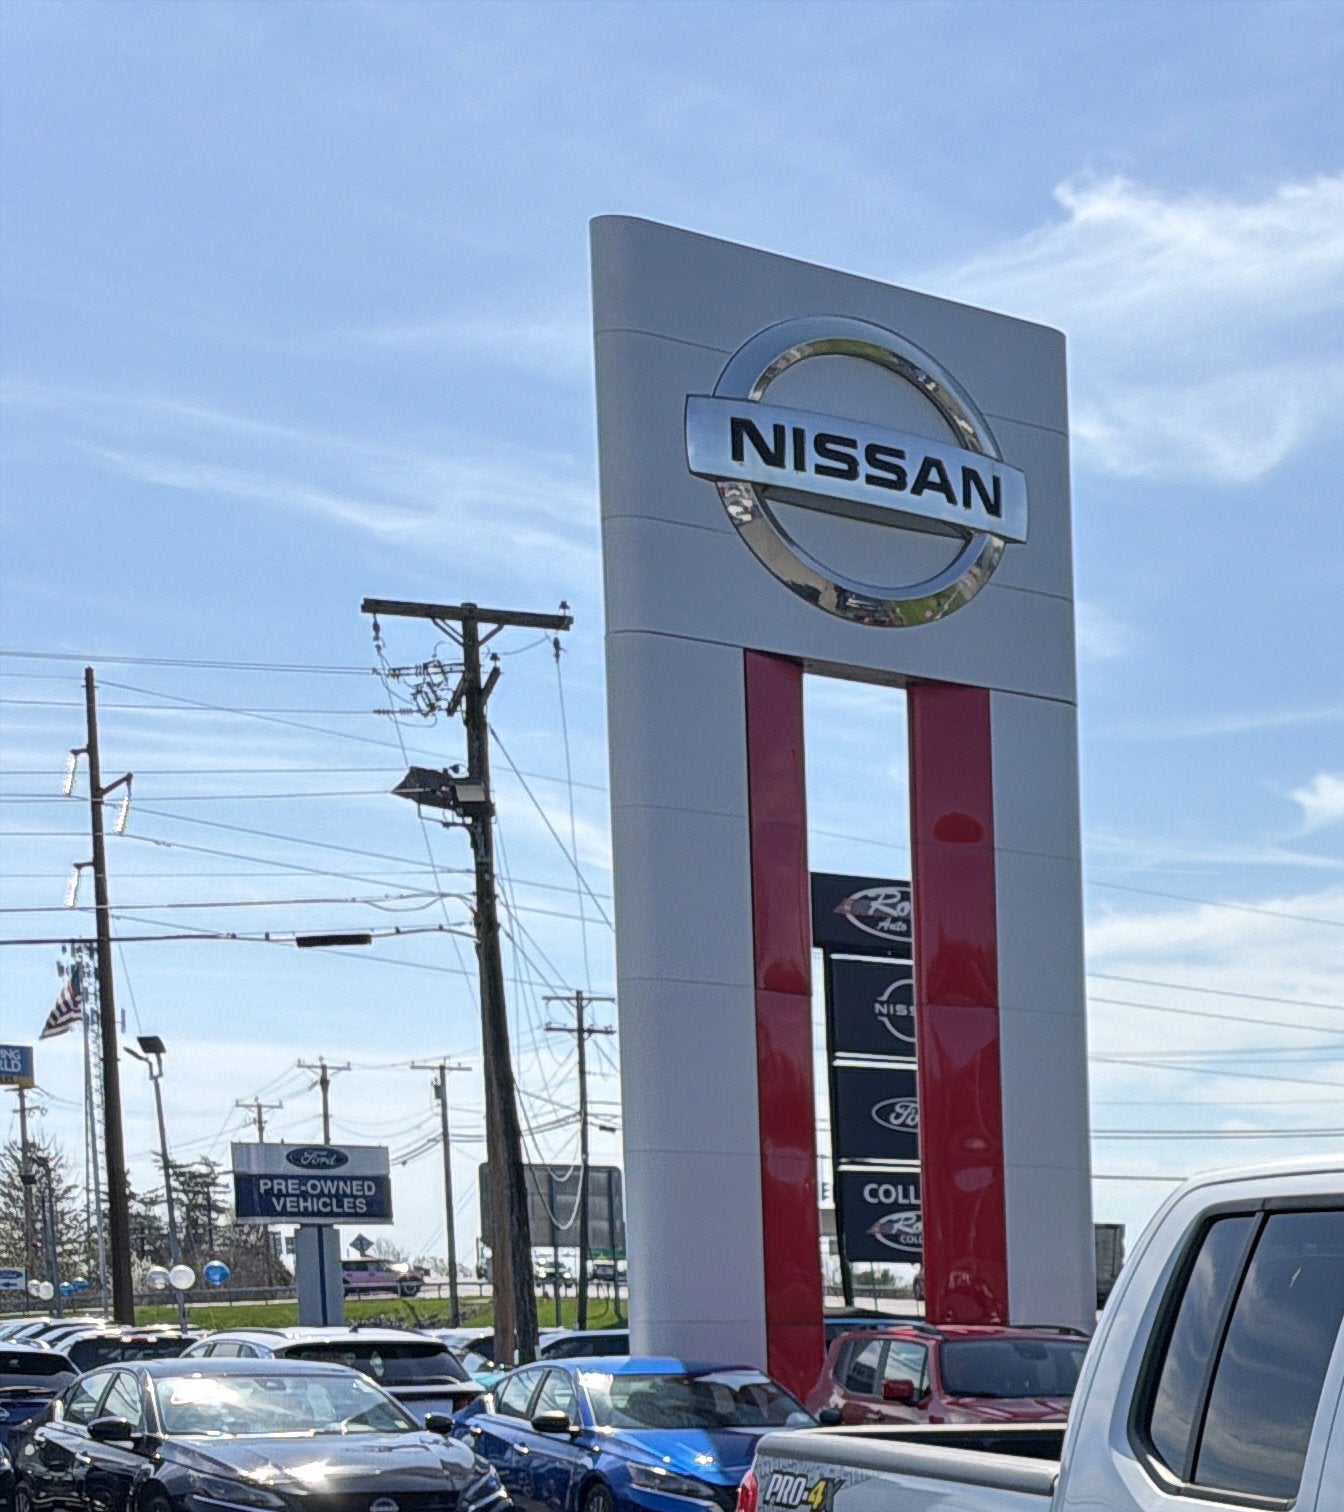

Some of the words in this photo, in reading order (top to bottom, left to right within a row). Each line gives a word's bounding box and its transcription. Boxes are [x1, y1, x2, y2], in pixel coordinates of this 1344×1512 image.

[729, 416, 1003, 519] NISSAN
[300, 1149, 338, 1166] Ford
[258, 1178, 377, 1196] PRE-OWNED
[271, 1196, 368, 1213] VEHICLES
